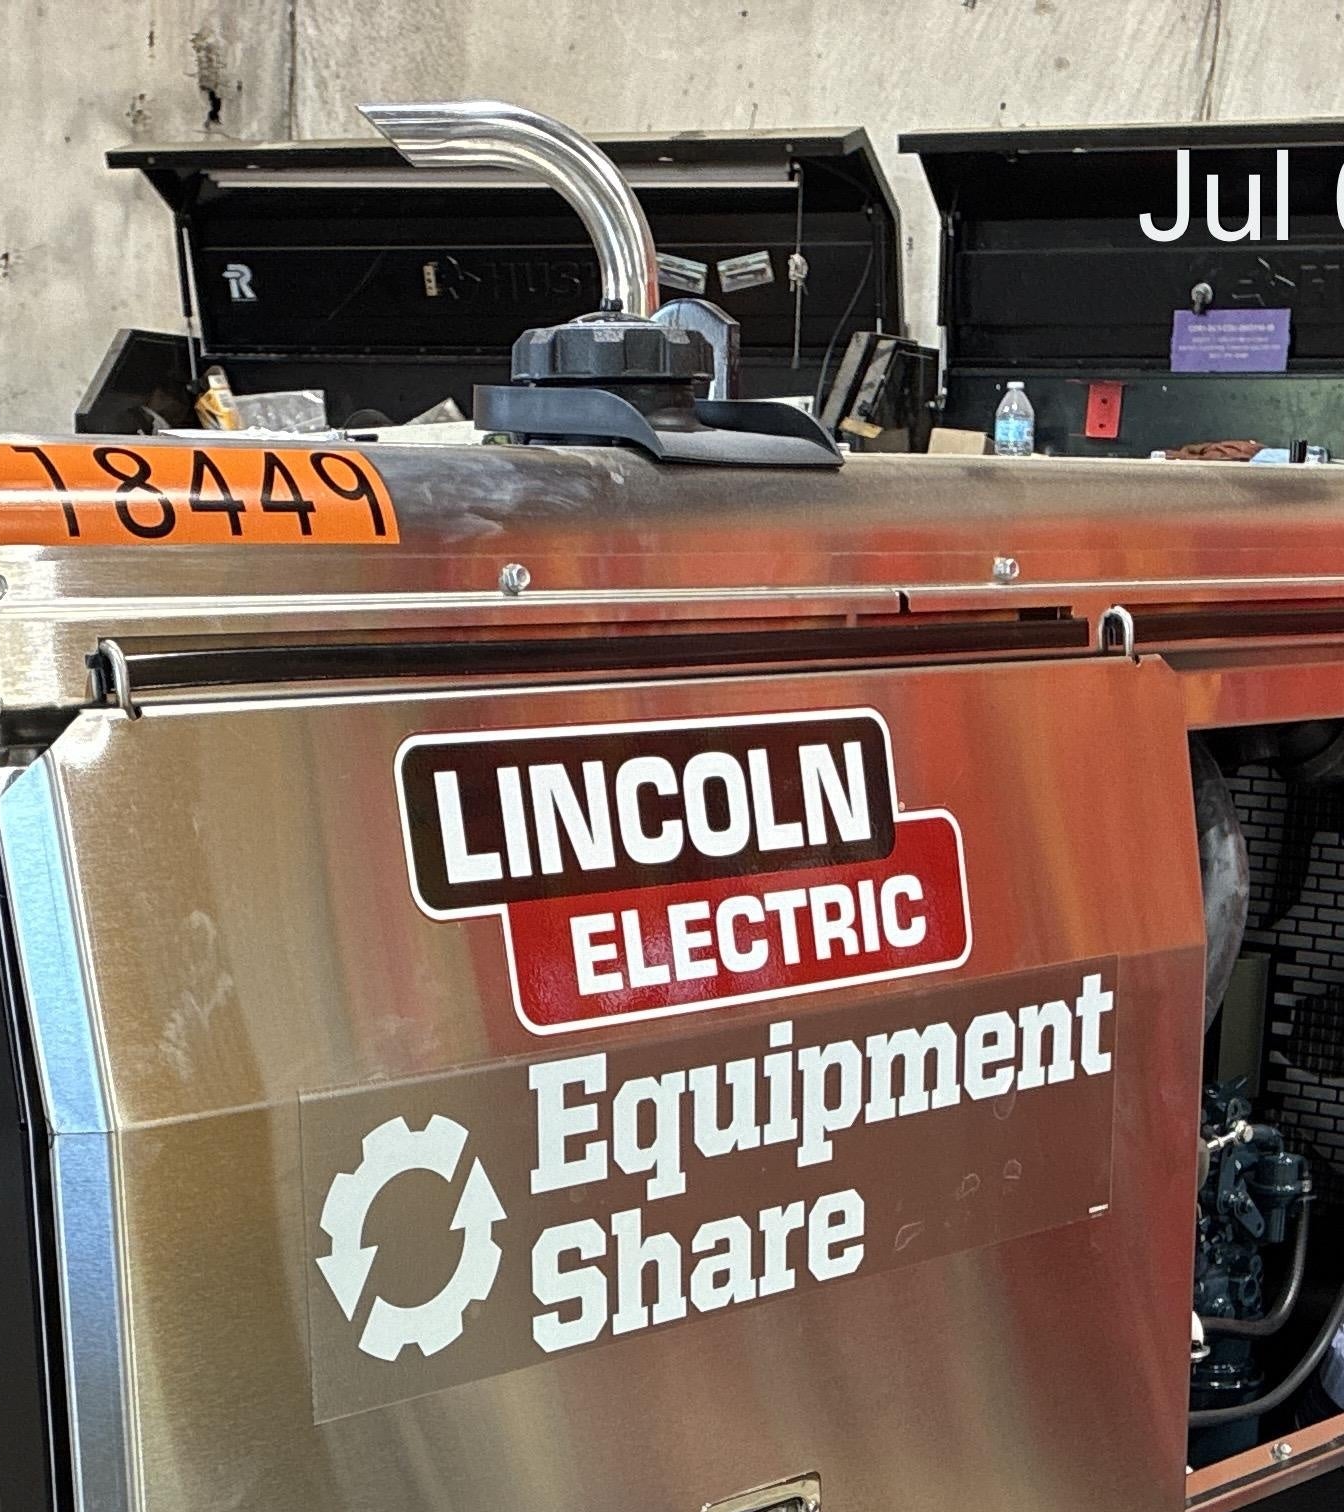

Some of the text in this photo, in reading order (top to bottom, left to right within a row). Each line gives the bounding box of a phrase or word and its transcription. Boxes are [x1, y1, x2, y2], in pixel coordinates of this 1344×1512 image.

[432, 740, 874, 885] LINCOLN
[568, 873, 927, 996] ELECTRIC
[528, 973, 1115, 1201] Equipment
[532, 1188, 865, 1353] Share
